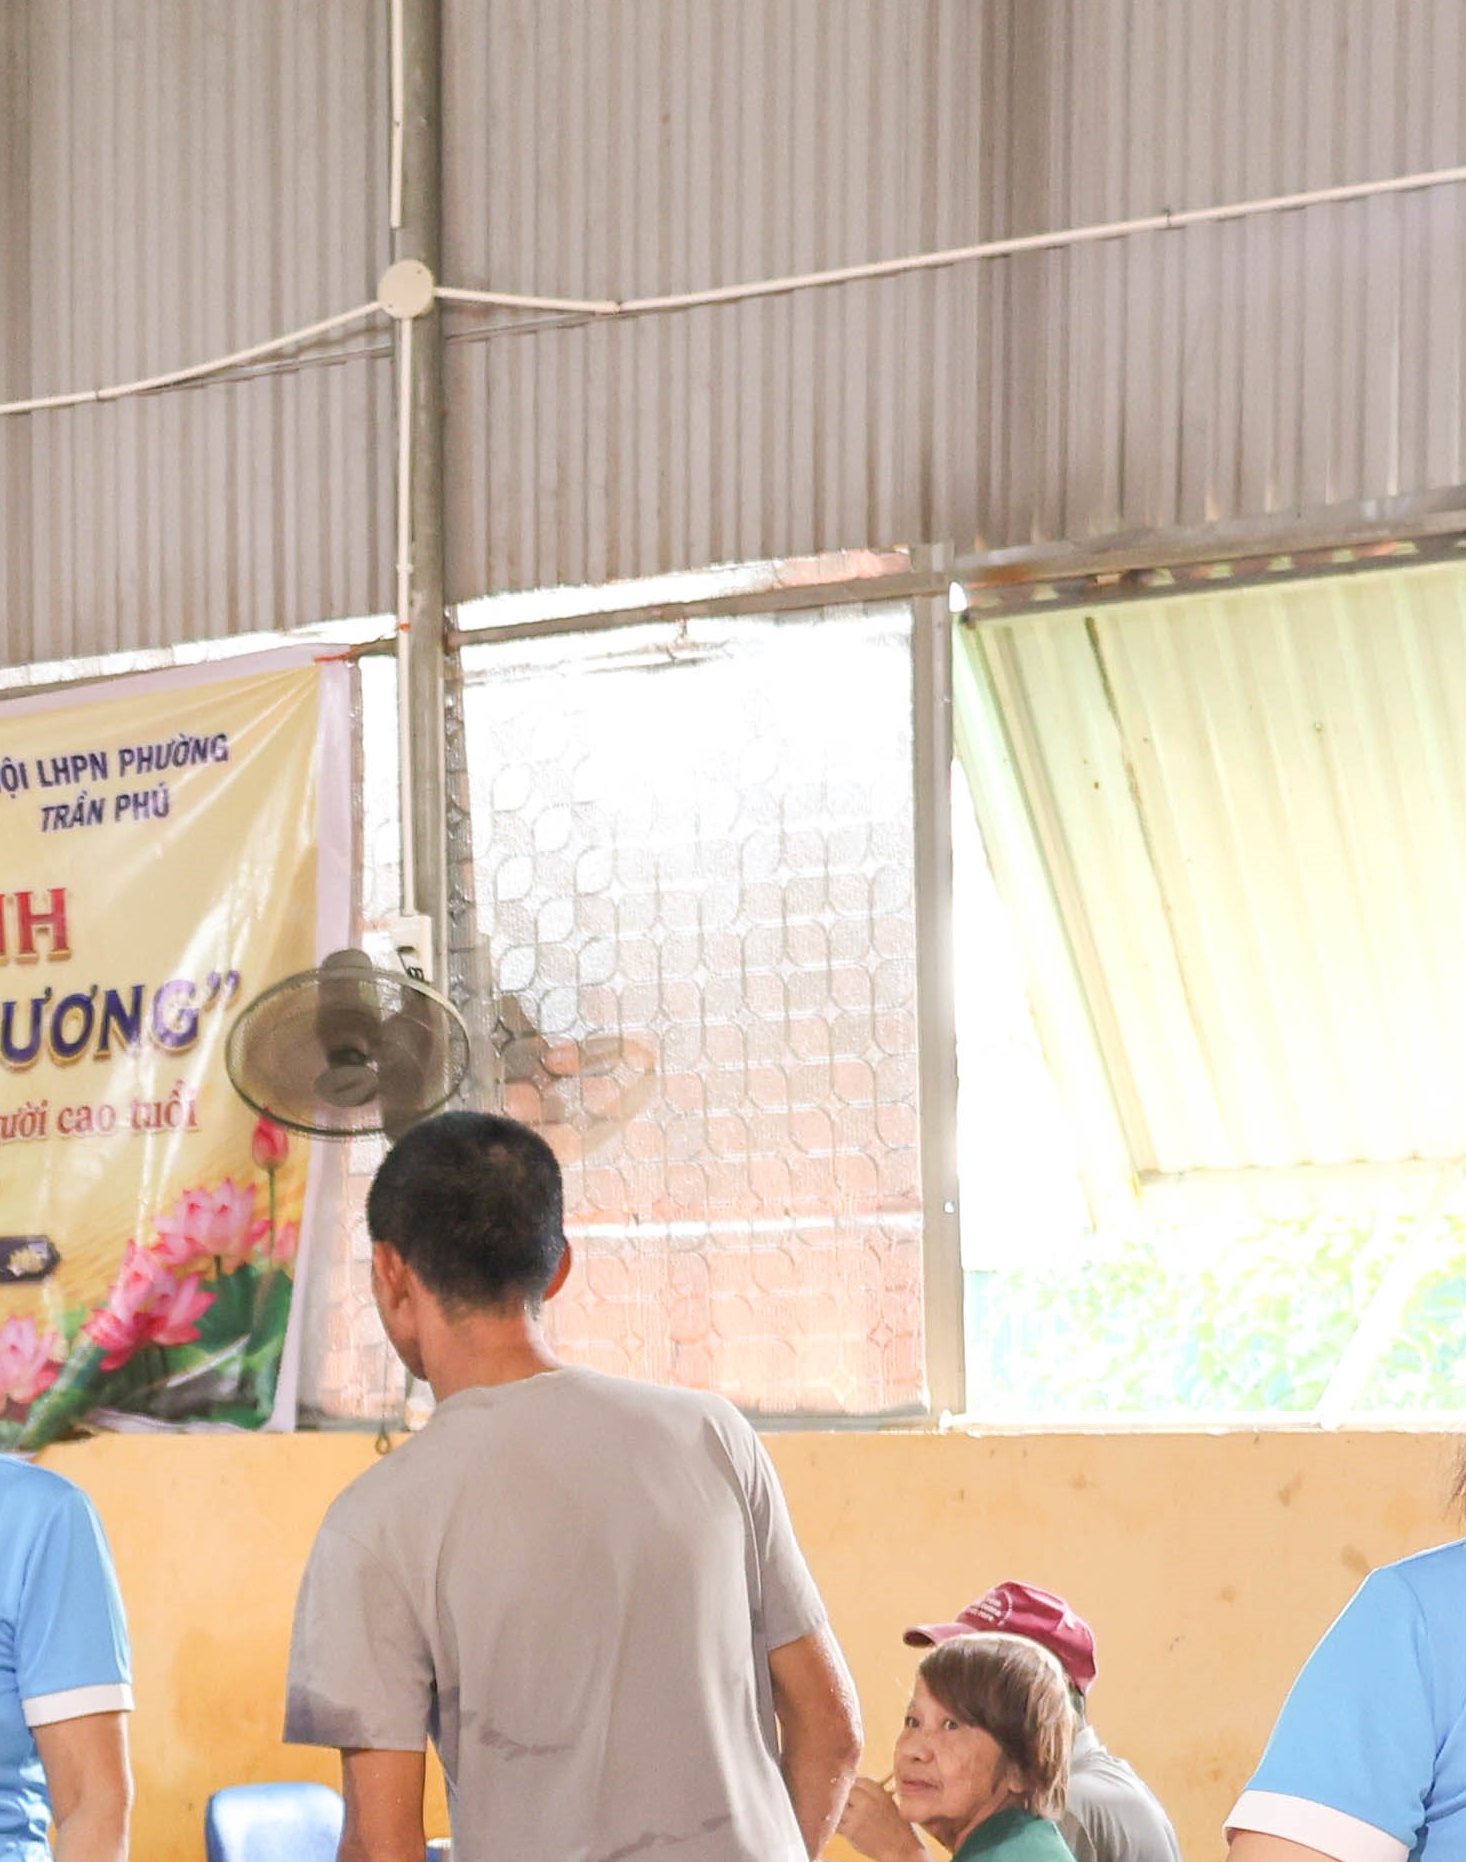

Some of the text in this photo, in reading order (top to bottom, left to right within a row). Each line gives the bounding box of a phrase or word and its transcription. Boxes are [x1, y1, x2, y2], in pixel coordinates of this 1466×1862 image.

[35, 751, 109, 788] LHPN
[117, 732, 231, 778] PHƯỜNG
[40, 781, 171, 832] TRẦN PHÚ
[57, 1104, 117, 1134] cao
[131, 1079, 199, 1131] tuổi
